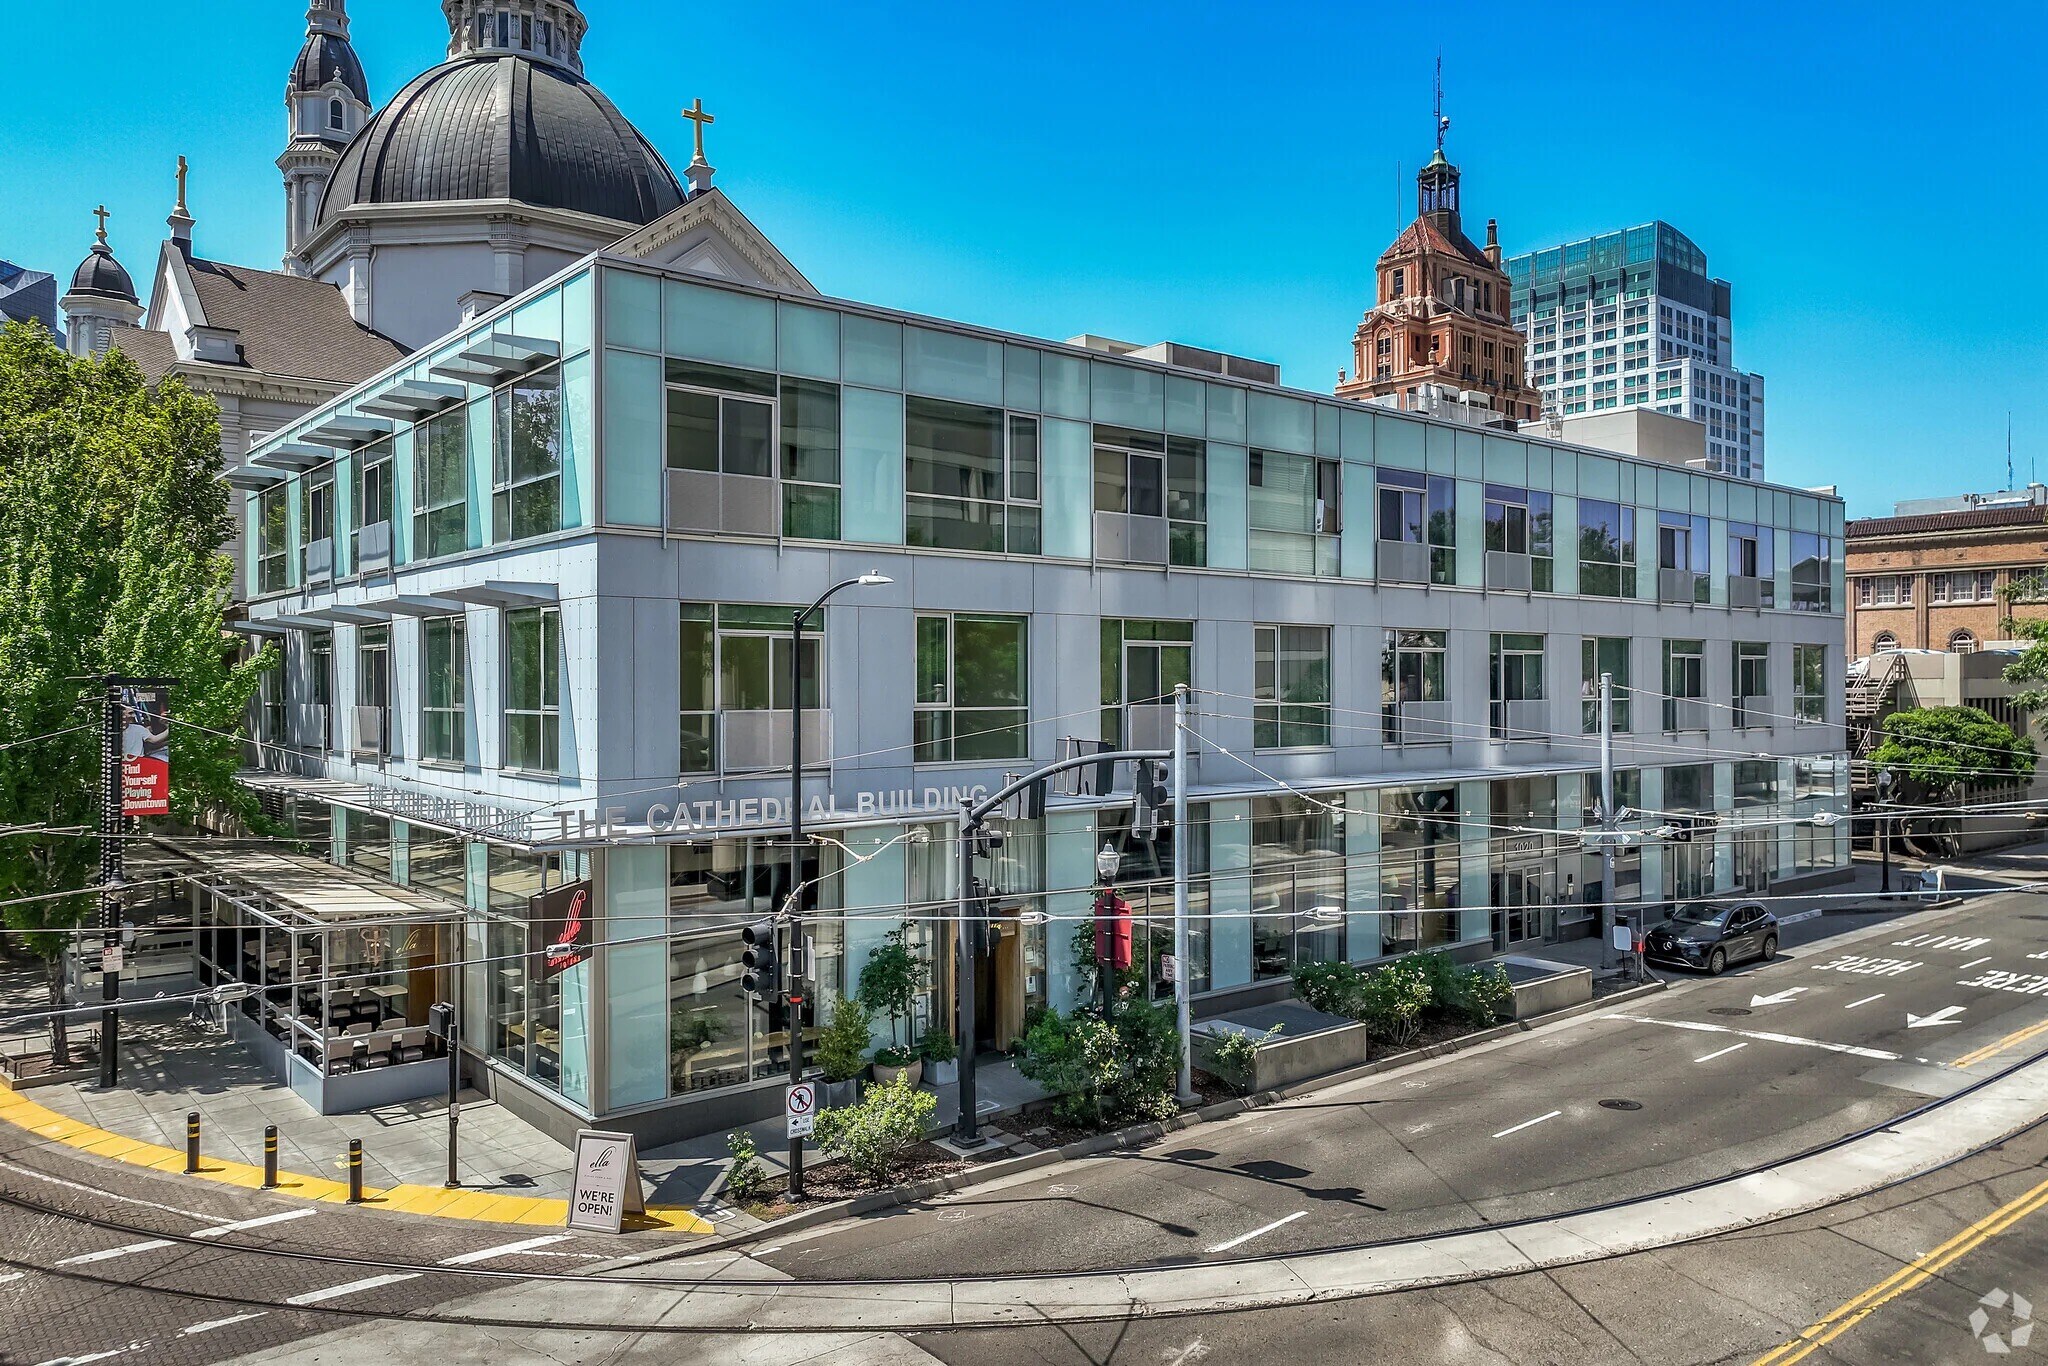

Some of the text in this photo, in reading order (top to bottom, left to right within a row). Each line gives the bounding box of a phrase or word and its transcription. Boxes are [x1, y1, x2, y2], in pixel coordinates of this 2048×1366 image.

[124, 763, 141, 775] Find
[124, 774, 158, 786] Yourself
[124, 786, 152, 799] Playing
[124, 798, 167, 811] Downtown
[367, 782, 532, 842] THE CATHEDRAL BUILDING
[552, 804, 628, 840] THE
[857, 784, 988, 818] BUILDING
[1514, 840, 1534, 853] 1020
[395, 928, 421, 954] ella
[1891, 933, 1992, 951] WAIT
[1810, 955, 1925, 977] HERE
[589, 1145, 617, 1173] ella
[579, 1188, 615, 1204] WE'RE
[578, 1202, 612, 1216] OPEN!
